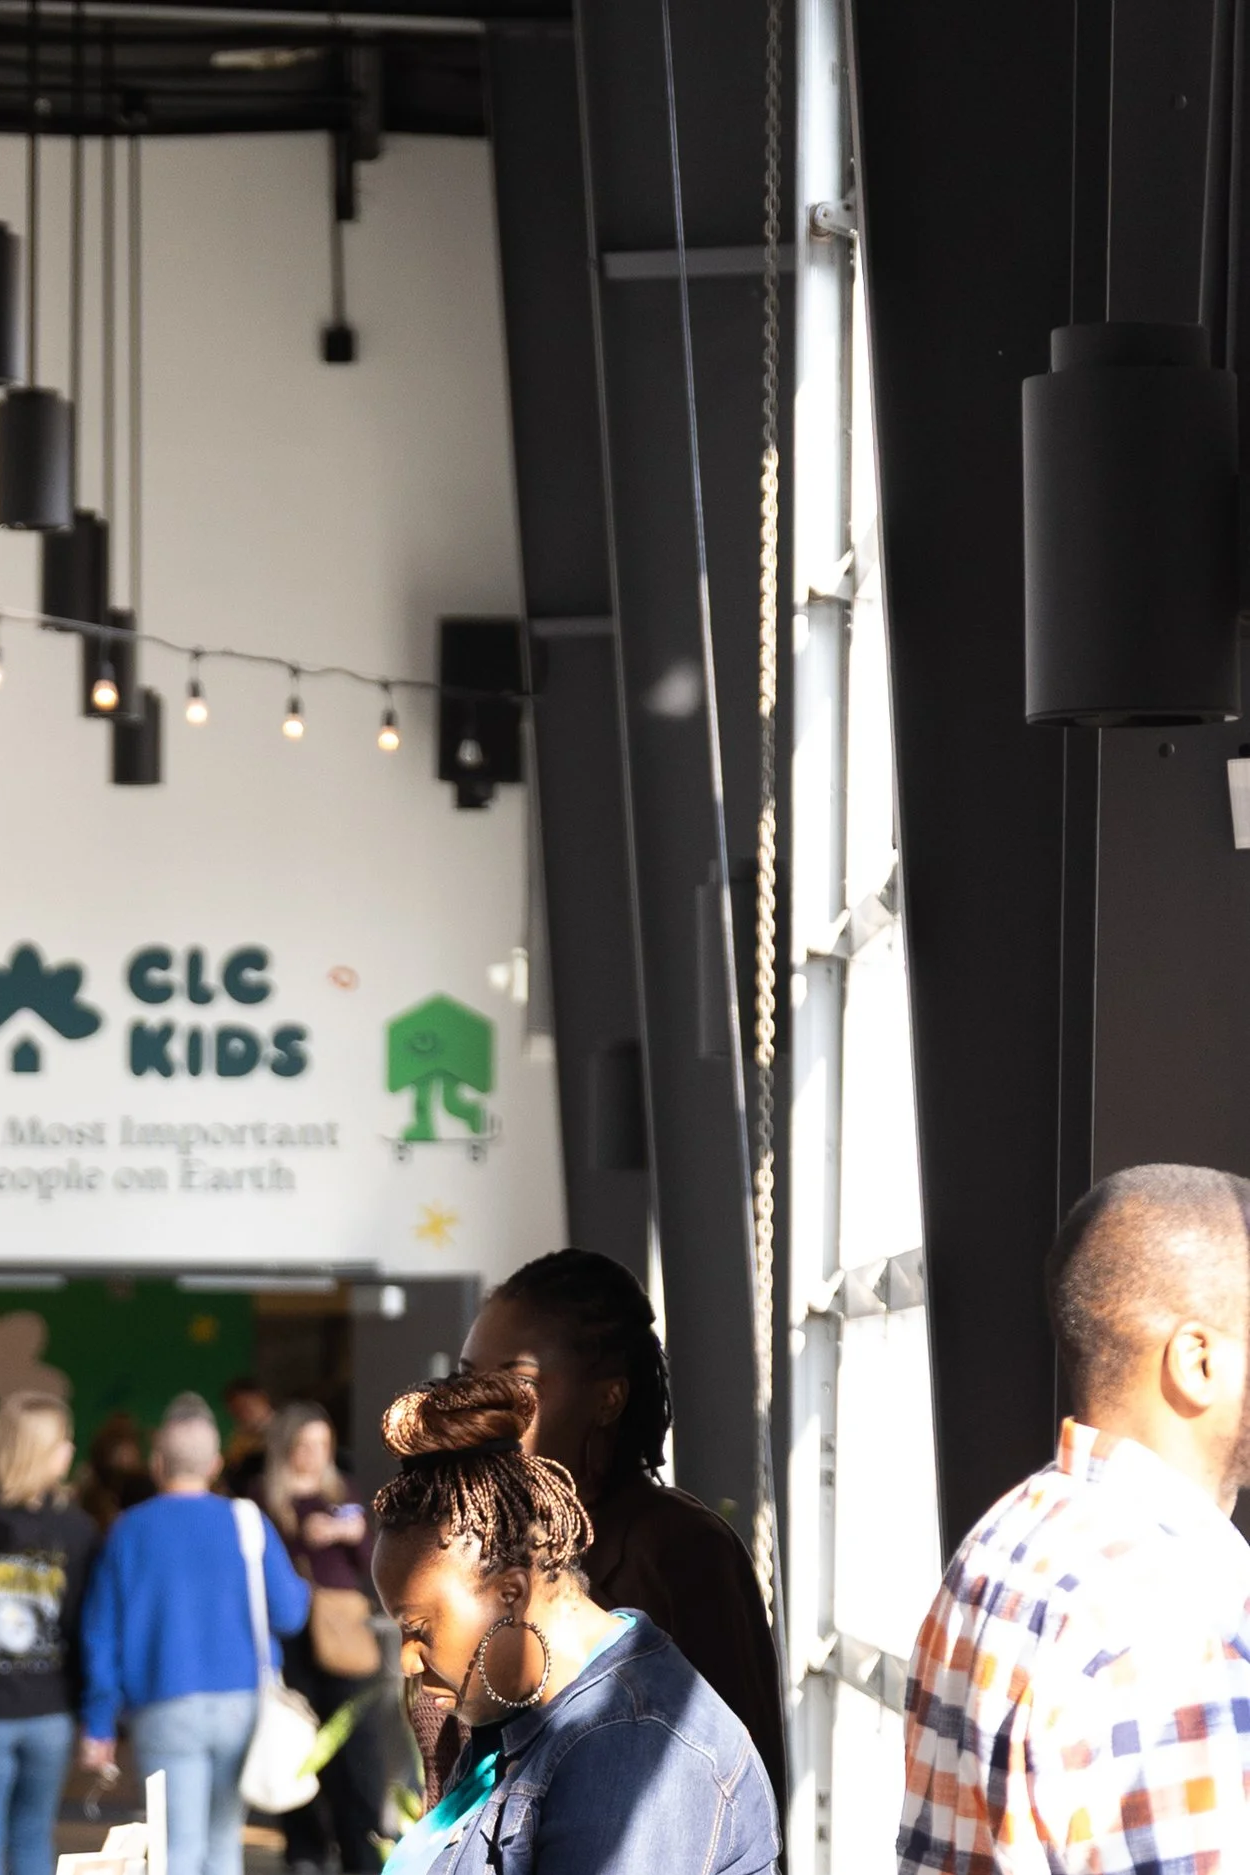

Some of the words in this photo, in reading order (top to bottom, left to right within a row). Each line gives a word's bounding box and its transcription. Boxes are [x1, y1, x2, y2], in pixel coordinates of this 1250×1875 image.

[128, 944, 273, 1005] CLC
[129, 1021, 309, 1078] KIDS
[2, 1114, 109, 1147] Most
[118, 1114, 341, 1156] Important
[111, 1164, 169, 1191] on
[178, 1157, 298, 1191] Earth
